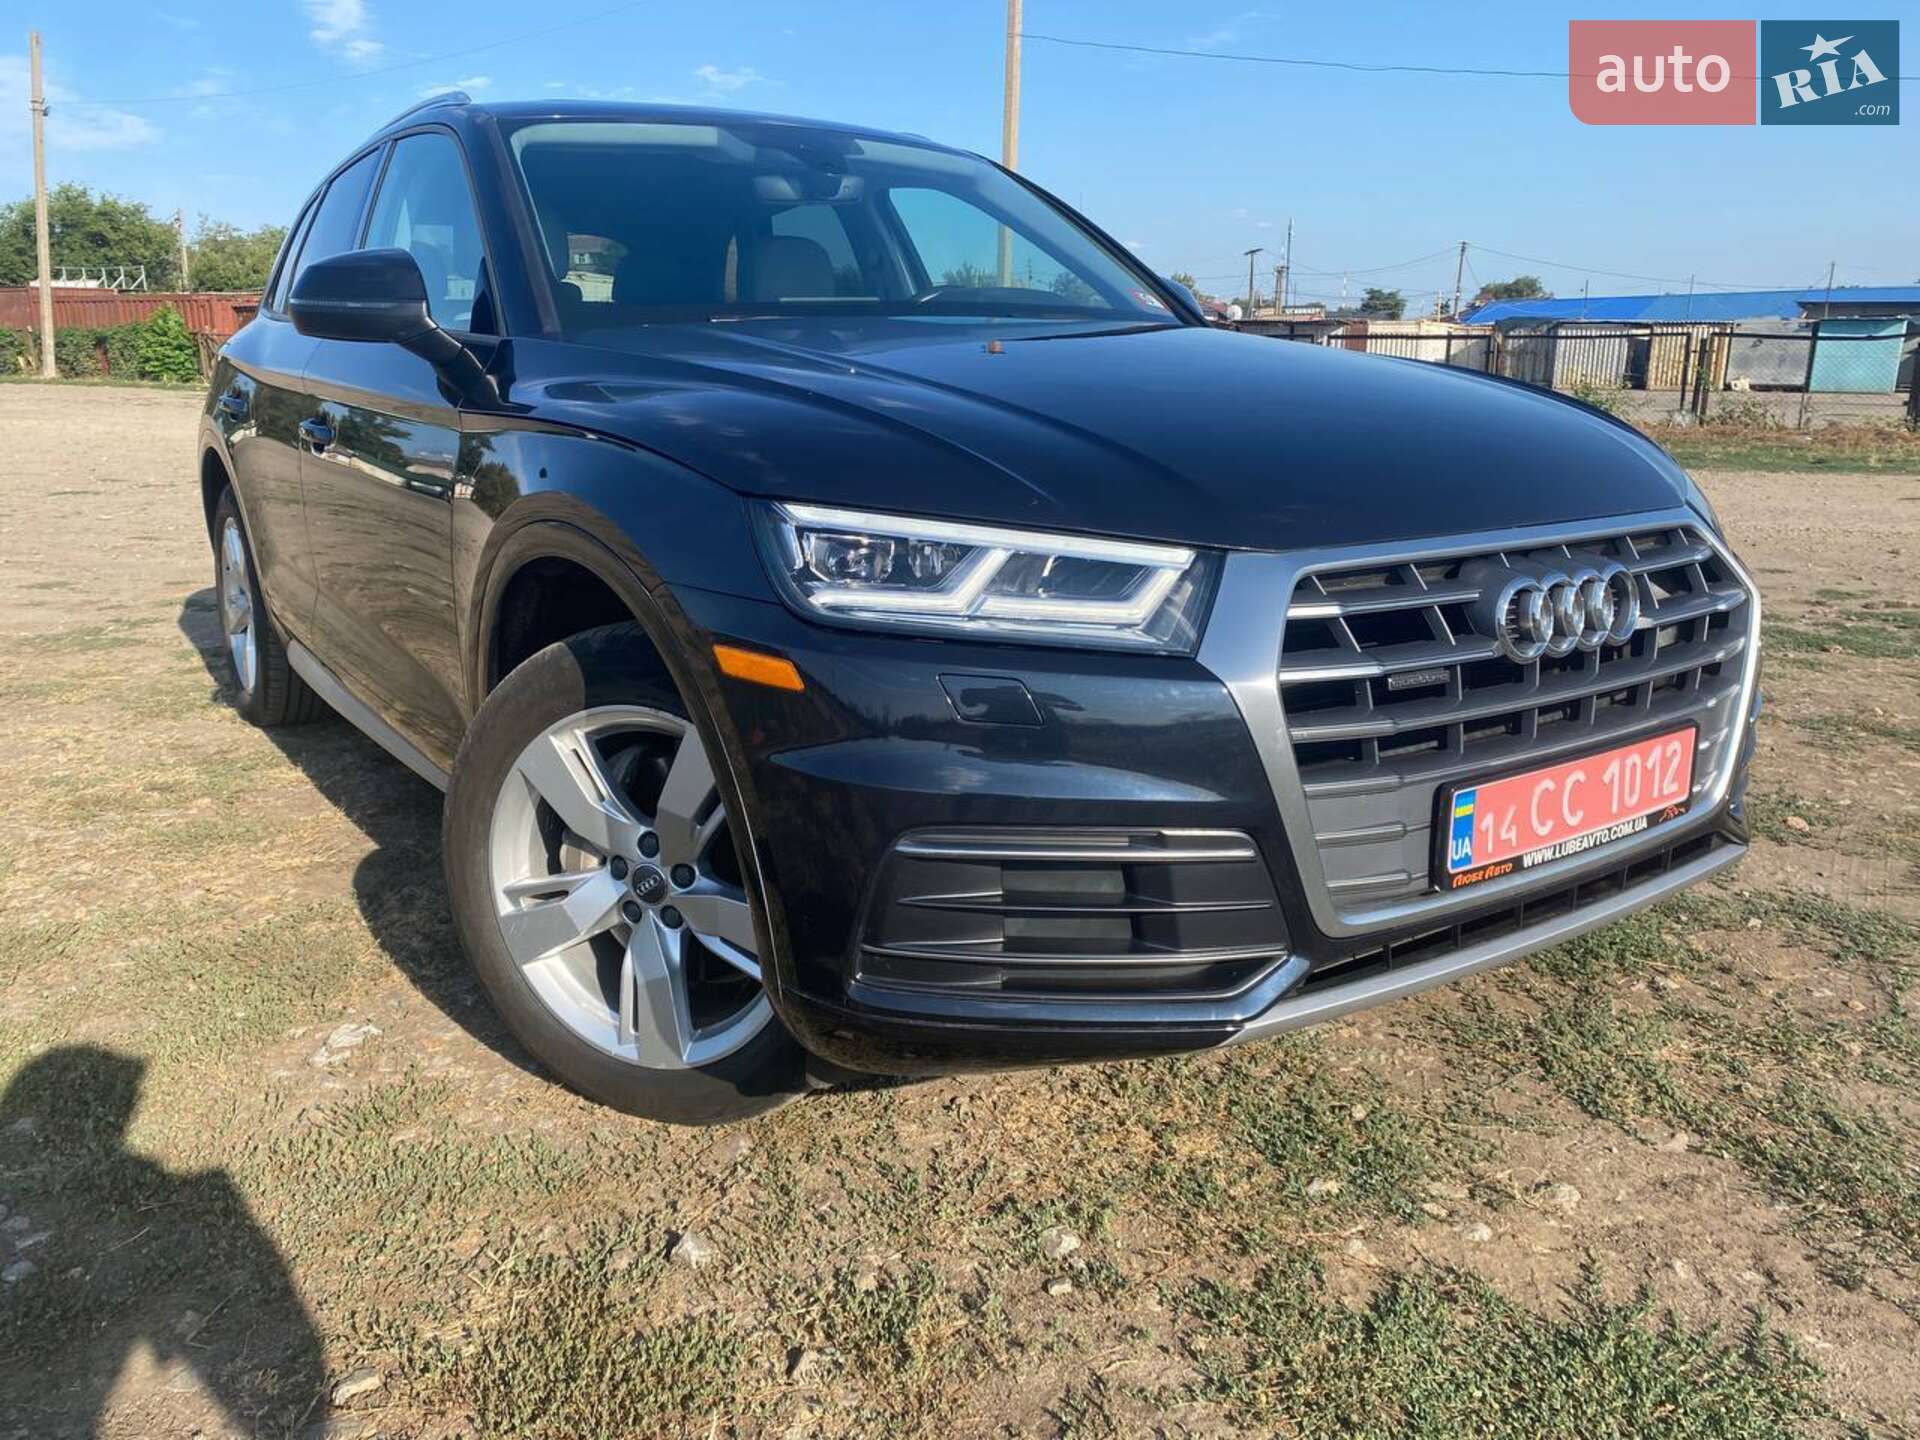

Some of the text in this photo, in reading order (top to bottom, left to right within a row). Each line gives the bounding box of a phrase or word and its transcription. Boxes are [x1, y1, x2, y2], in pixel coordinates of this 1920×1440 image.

[1480, 741, 1682, 854] 14 CC 1012
[1452, 836, 1472, 861] UA
